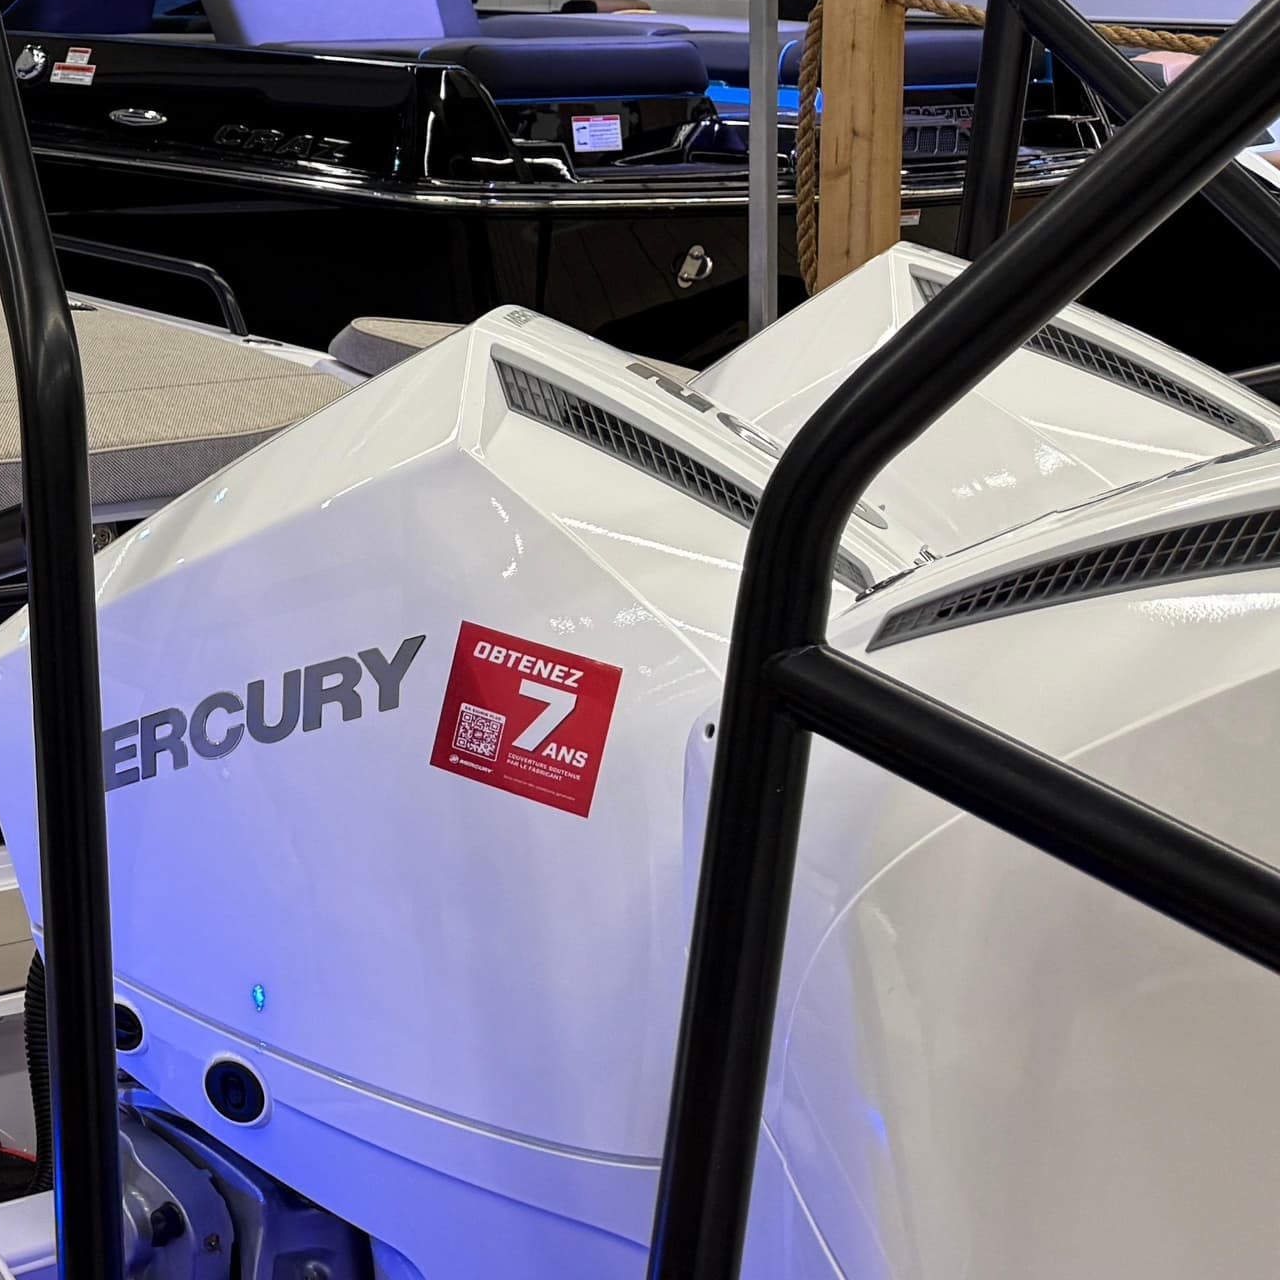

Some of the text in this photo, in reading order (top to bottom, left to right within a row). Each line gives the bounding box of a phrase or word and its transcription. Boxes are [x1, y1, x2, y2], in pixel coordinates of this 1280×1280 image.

[473, 641, 584, 688] OBTENEZ
[101, 635, 426, 793] ERCURY
[512, 678, 577, 752] 7
[507, 752, 547, 769] COUVERTURE
[519, 762, 527, 770] LE
[528, 765, 562, 781] FABRICANT
[542, 742, 588, 768] ANS
